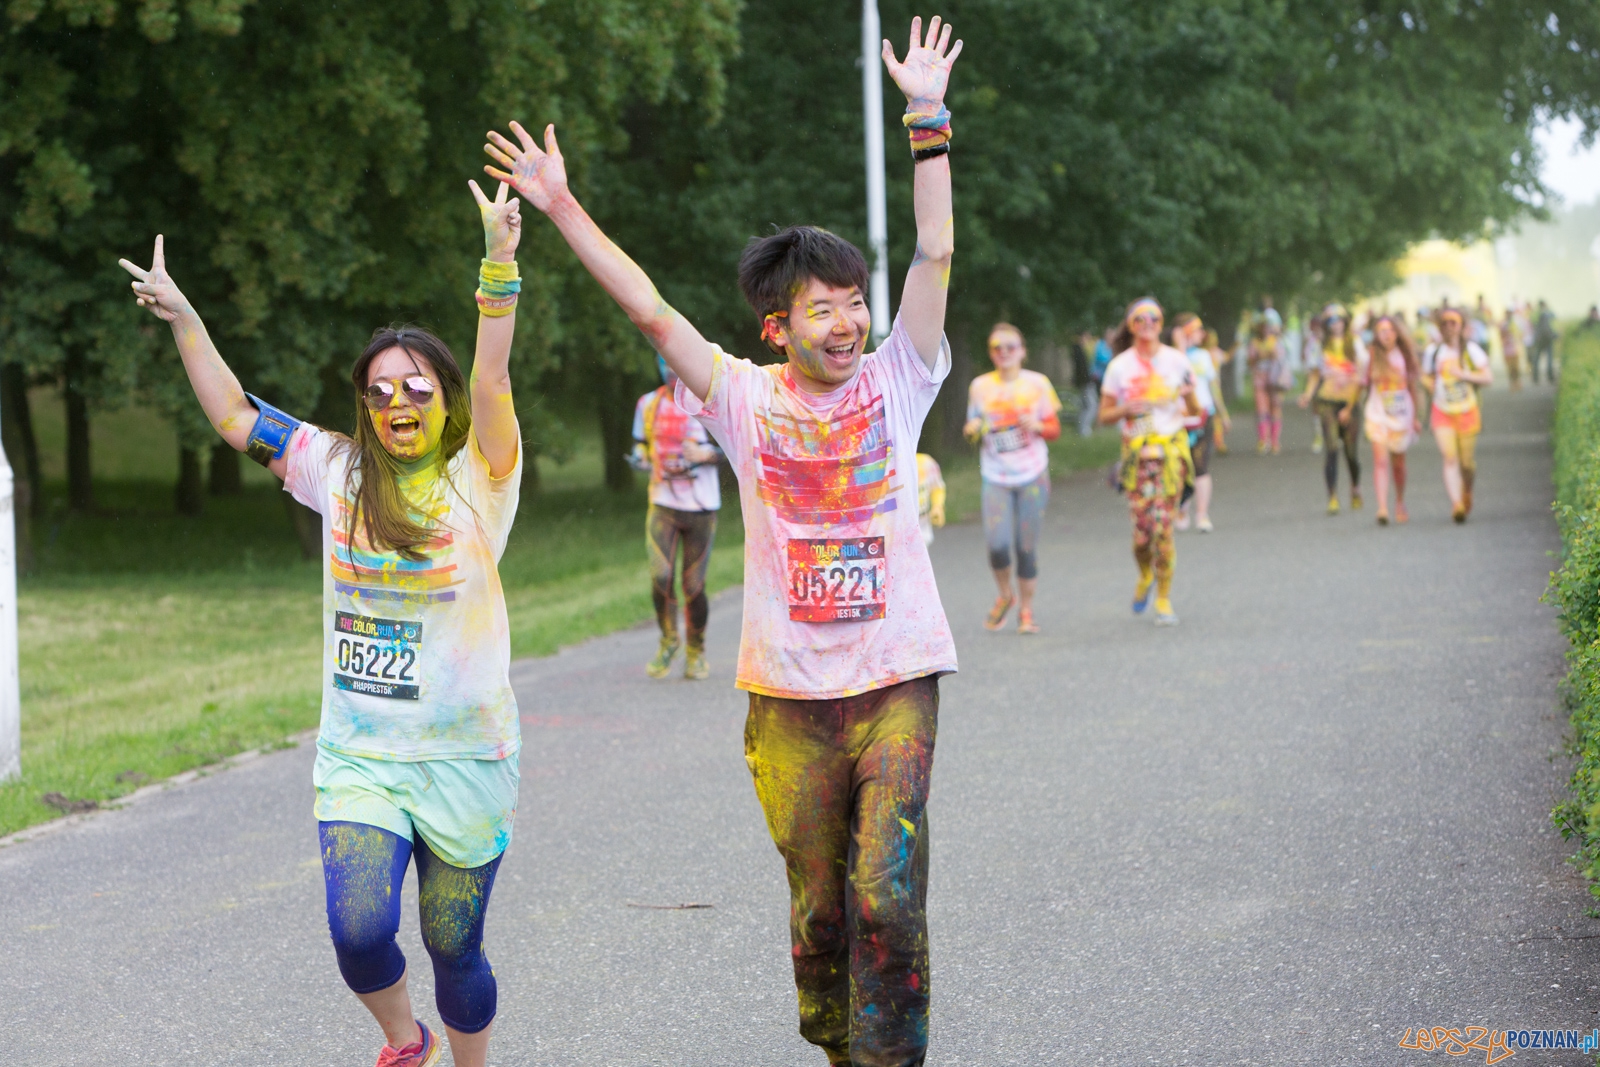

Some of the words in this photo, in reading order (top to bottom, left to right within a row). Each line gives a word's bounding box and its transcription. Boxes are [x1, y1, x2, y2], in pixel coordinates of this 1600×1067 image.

[810, 544, 840, 558] COLOR
[840, 544, 859, 557] RUN
[792, 564, 878, 602] 05221
[340, 616, 353, 631] THE
[352, 619, 377, 635] COLOR
[376, 624, 394, 637] RUN
[338, 638, 416, 681] 05222
[352, 680, 393, 695] #HAPPIEST5K
